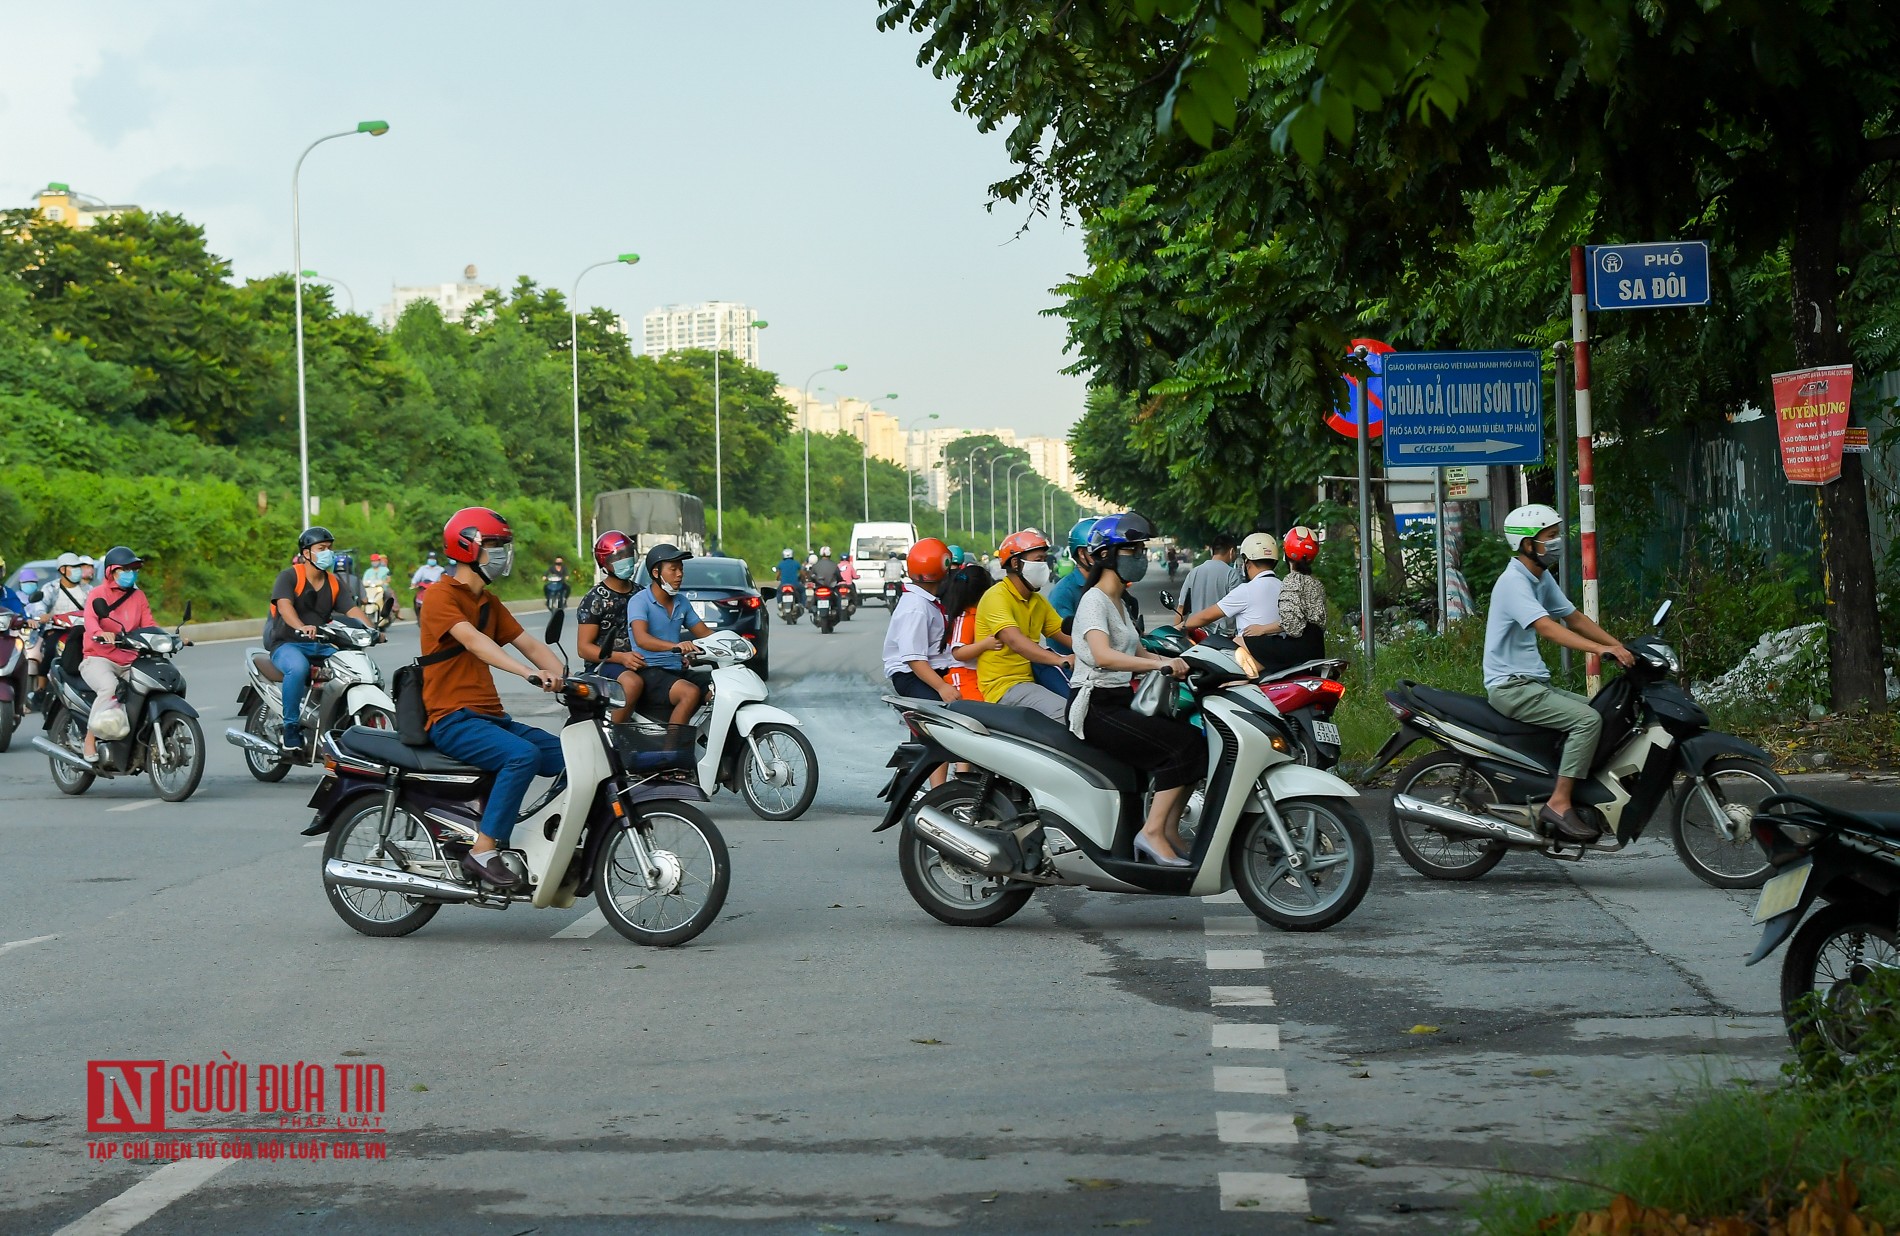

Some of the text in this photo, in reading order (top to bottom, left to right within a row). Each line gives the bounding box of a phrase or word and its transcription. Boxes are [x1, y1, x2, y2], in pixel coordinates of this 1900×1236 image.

[1644, 247, 1684, 267] PHỐ
[1618, 271, 1687, 301] SA ĐÔI
[1463, 361, 1478, 369] NAM
[1479, 360, 1499, 369] THÀNH
[1513, 360, 1522, 368] HÀ
[1388, 374, 1537, 418] CHÙA CẢ (LINH SƠN TỰ)
[1780, 399, 1818, 420] TUYỂN
[1389, 423, 1403, 435] PHỐ
[1403, 426, 1413, 435] SA
[1433, 423, 1446, 434] PHÚ
[1466, 425, 1481, 433] NAM
[1507, 424, 1514, 432] TP
[1514, 422, 1524, 432] HÀ
[1414, 444, 1455, 453] CÁCH 50M
